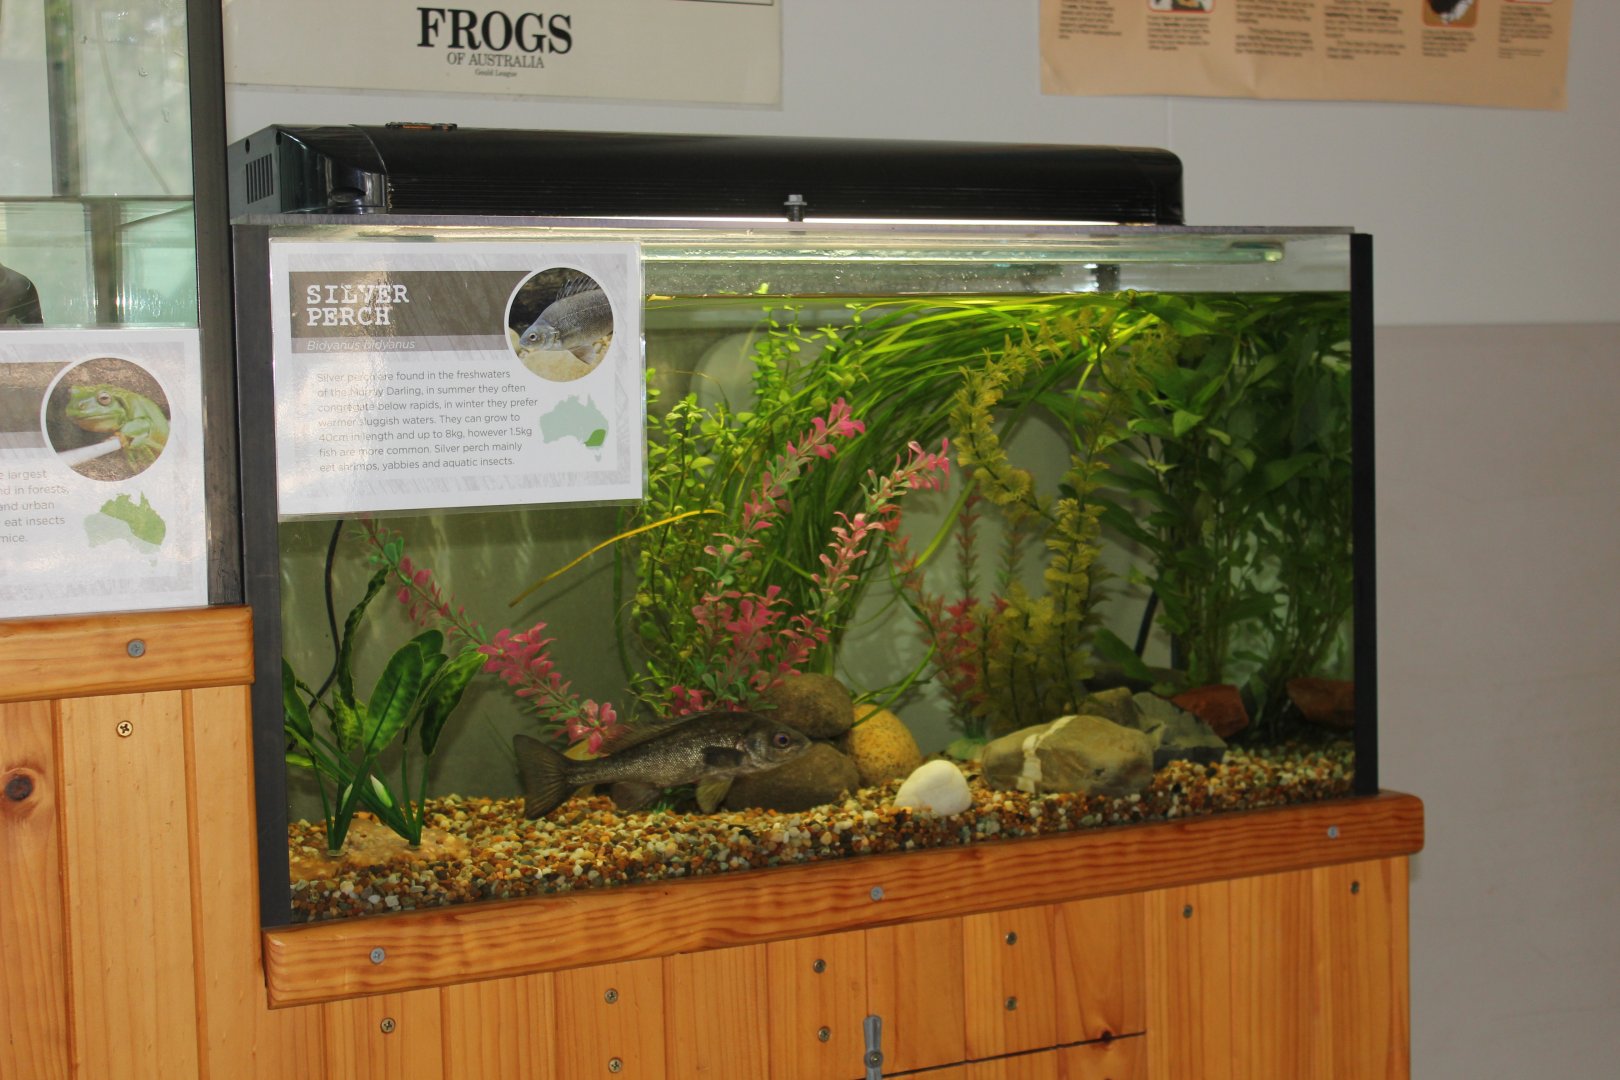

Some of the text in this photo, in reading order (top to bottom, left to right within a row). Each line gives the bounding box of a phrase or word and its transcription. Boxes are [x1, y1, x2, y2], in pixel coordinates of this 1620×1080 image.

[416, 7, 573, 55] FROGS
[447, 51, 545, 69] OF AUSTRALIA
[306, 284, 410, 305] SILVER
[306, 306, 394, 327] PERCH
[317, 373, 345, 383] Silver
[396, 371, 425, 381] found
[428, 371, 436, 380] in
[438, 370, 454, 380] the
[456, 370, 511, 379] freshwaters
[317, 389, 328, 398] of
[331, 388, 347, 397] the
[386, 386, 424, 397] Darling,
[426, 385, 435, 395] in
[437, 386, 476, 395] summer
[478, 384, 499, 395] they
[501, 383, 526, 393] often
[317, 397, 538, 414] congregate below rapids, in winter they prefer
[318, 413, 521, 428] warmer sluggish waters. They can grow to
[318, 432, 349, 442] 40cm
[351, 432, 360, 441] in
[362, 430, 394, 442] length
[396, 430, 415, 440] and
[417, 430, 431, 441] up
[433, 430, 443, 439] to
[467, 428, 508, 438] however
[510, 427, 533, 437] 1.5kg
[319, 441, 523, 457] fish are more common. Silver perch mainly
[319, 456, 515, 473] eat shrimps, yabbies and aquatic insects.
[8, 469, 48, 481] largest
[14, 486, 25, 495] in
[27, 484, 70, 495] forests,
[21, 500, 55, 511] urban
[4, 515, 66, 527] eat insects
